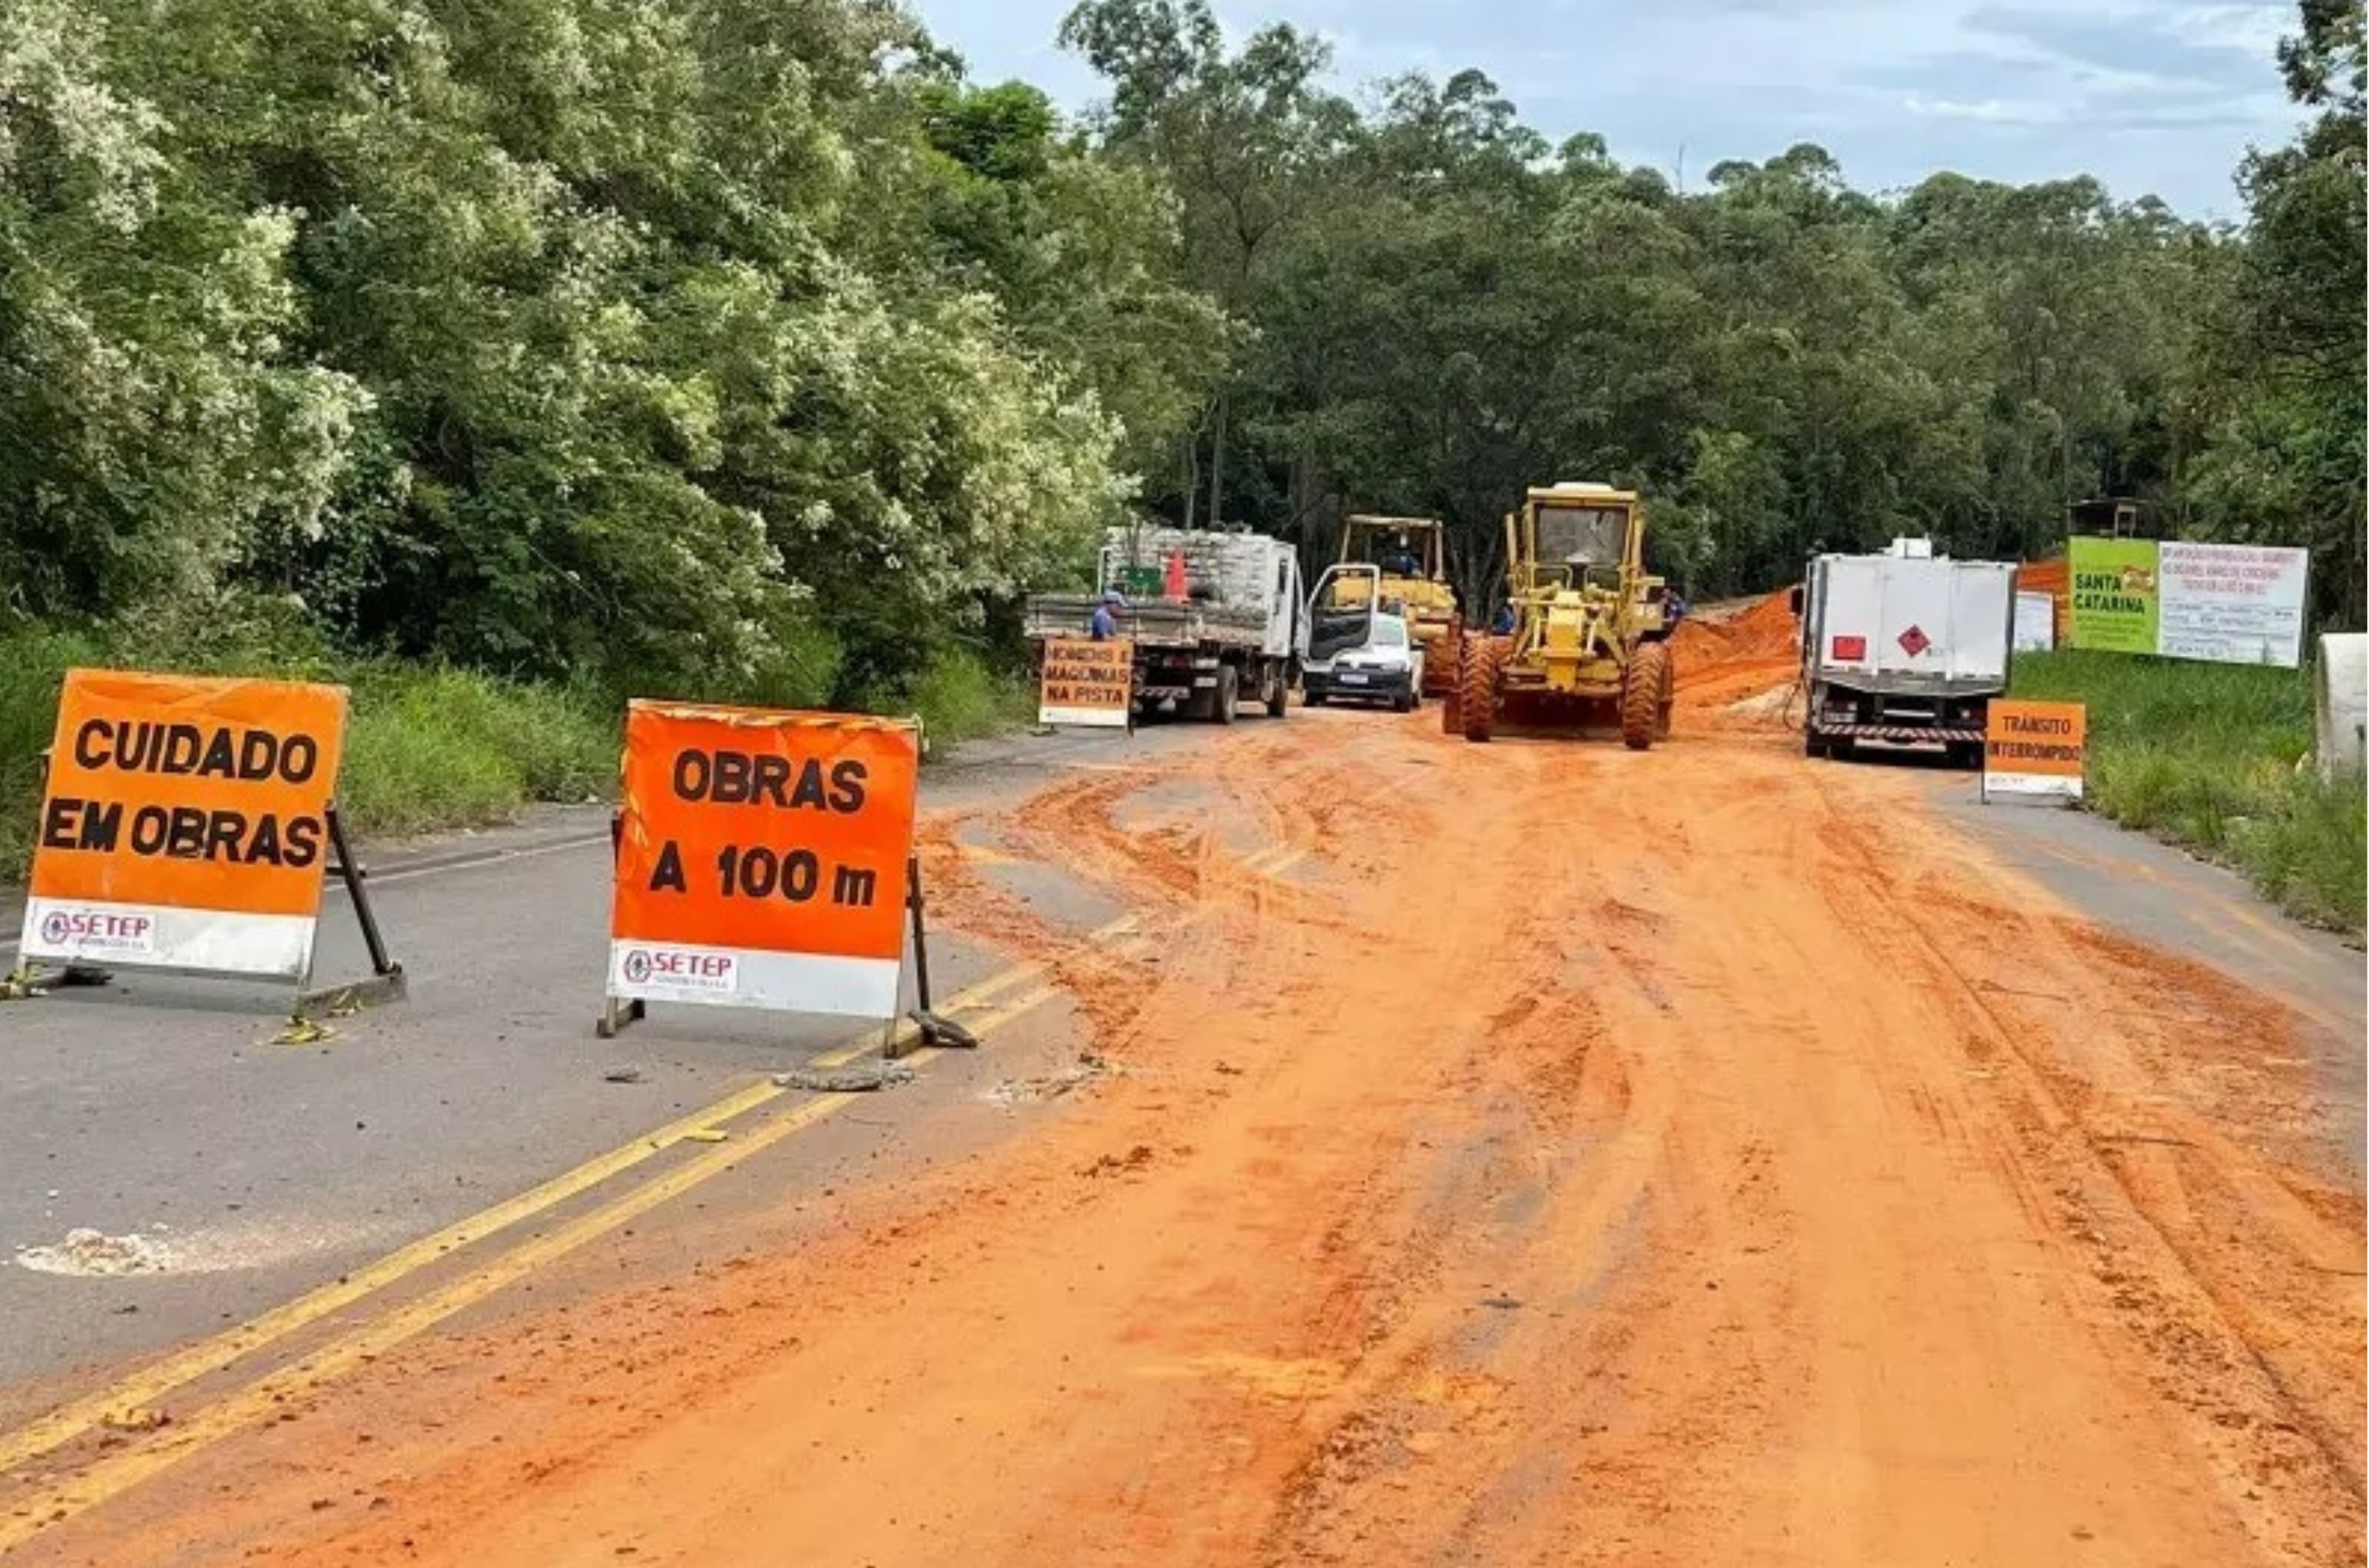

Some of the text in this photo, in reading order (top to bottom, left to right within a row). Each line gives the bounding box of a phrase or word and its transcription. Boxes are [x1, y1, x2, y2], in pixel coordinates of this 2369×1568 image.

[2076, 574, 2121, 591] SANTA
[2074, 595, 2145, 613] CATARINA
[1048, 687, 1123, 704] NA PISTA
[75, 719, 318, 783] CUIDADO
[674, 749, 867, 813] OBRAS
[43, 798, 321, 867] EM OBRAS
[649, 840, 686, 893] A
[718, 845, 818, 902] 100
[71, 914, 150, 936] SETEP
[655, 952, 731, 978] SETEP
